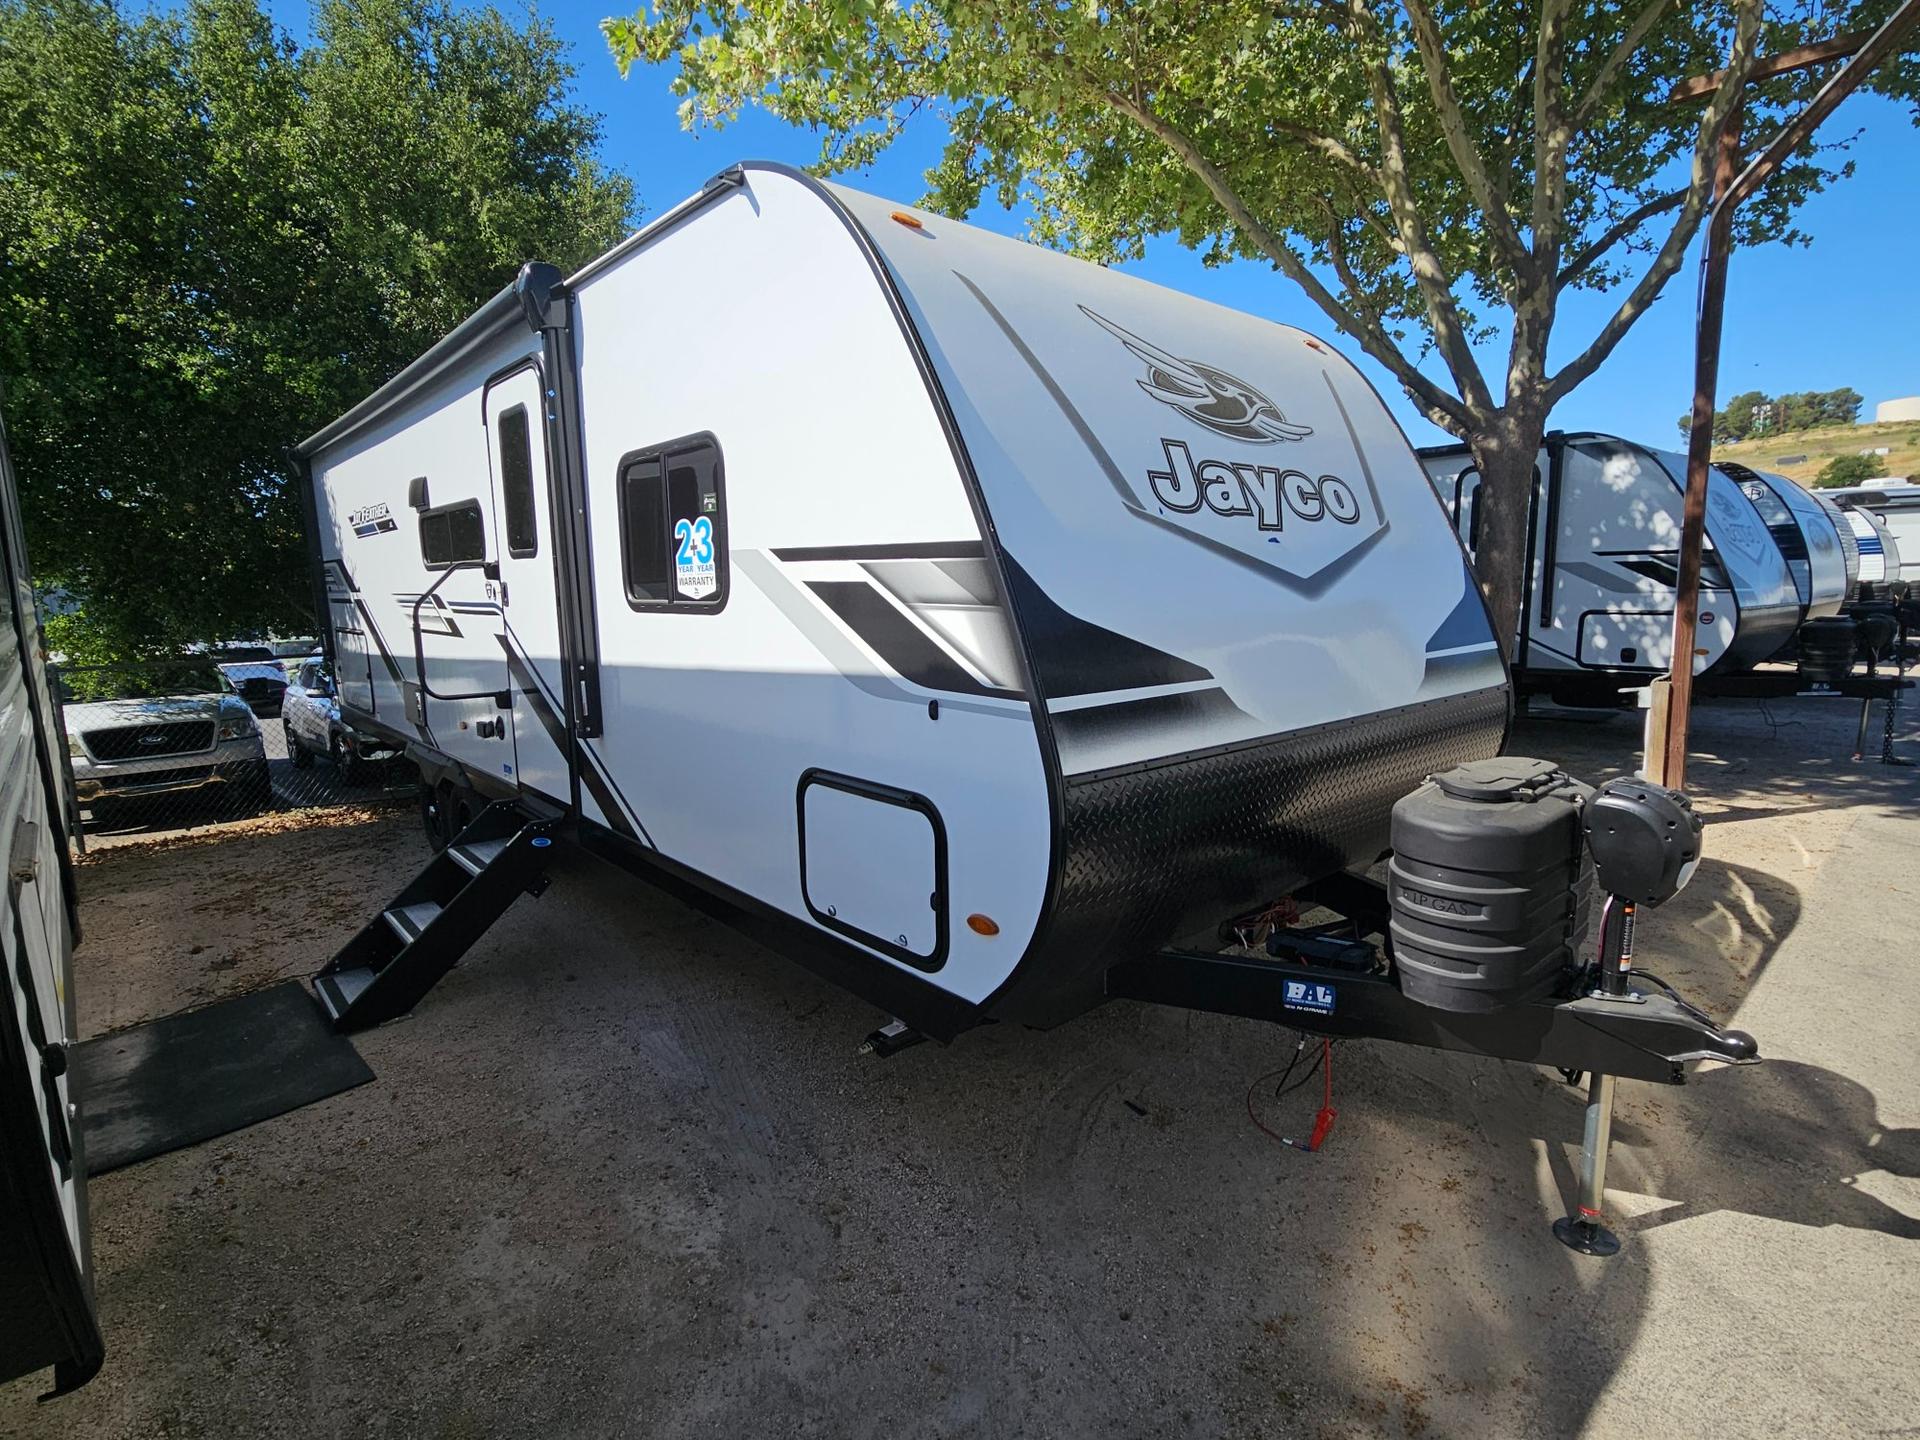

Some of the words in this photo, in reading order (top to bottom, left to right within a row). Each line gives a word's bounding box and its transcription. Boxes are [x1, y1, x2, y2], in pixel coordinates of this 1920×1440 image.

[1147, 438, 1360, 532] Jayco
[678, 565, 694, 573] YEAR
[697, 564, 714, 572] YEAR
[679, 576, 714, 586] WARRANTY
[1413, 893, 1428, 905] LP
[1432, 899, 1468, 915] GAS
[1287, 982, 1332, 1003] BAL
